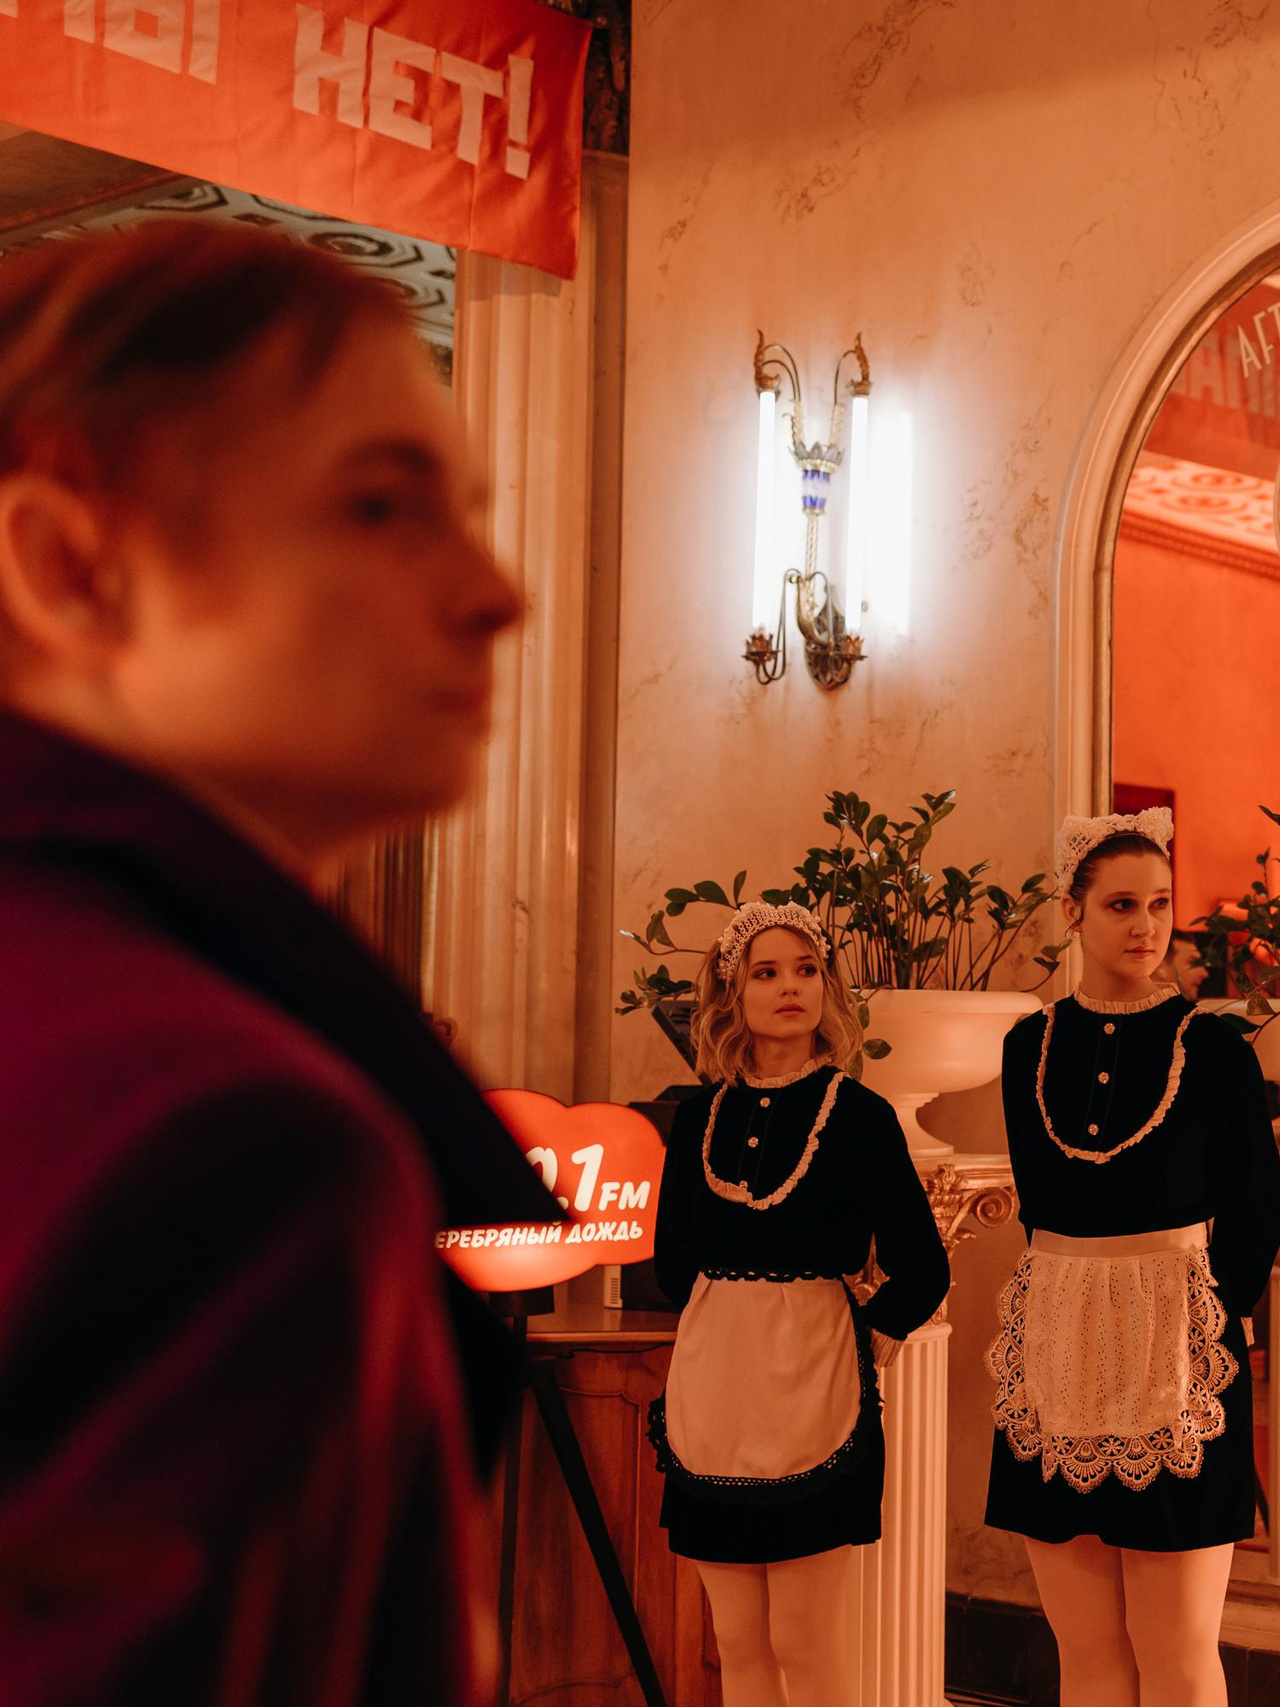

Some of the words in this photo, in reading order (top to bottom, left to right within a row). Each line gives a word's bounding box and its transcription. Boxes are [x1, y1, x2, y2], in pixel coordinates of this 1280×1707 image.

[292, 4, 535, 181] НЕТ!
[598, 1180, 651, 1211] FM
[434, 1221, 562, 1249] ЕРЕБРЯНЫЙ
[565, 1220, 644, 1245] ДОЖДЬ
